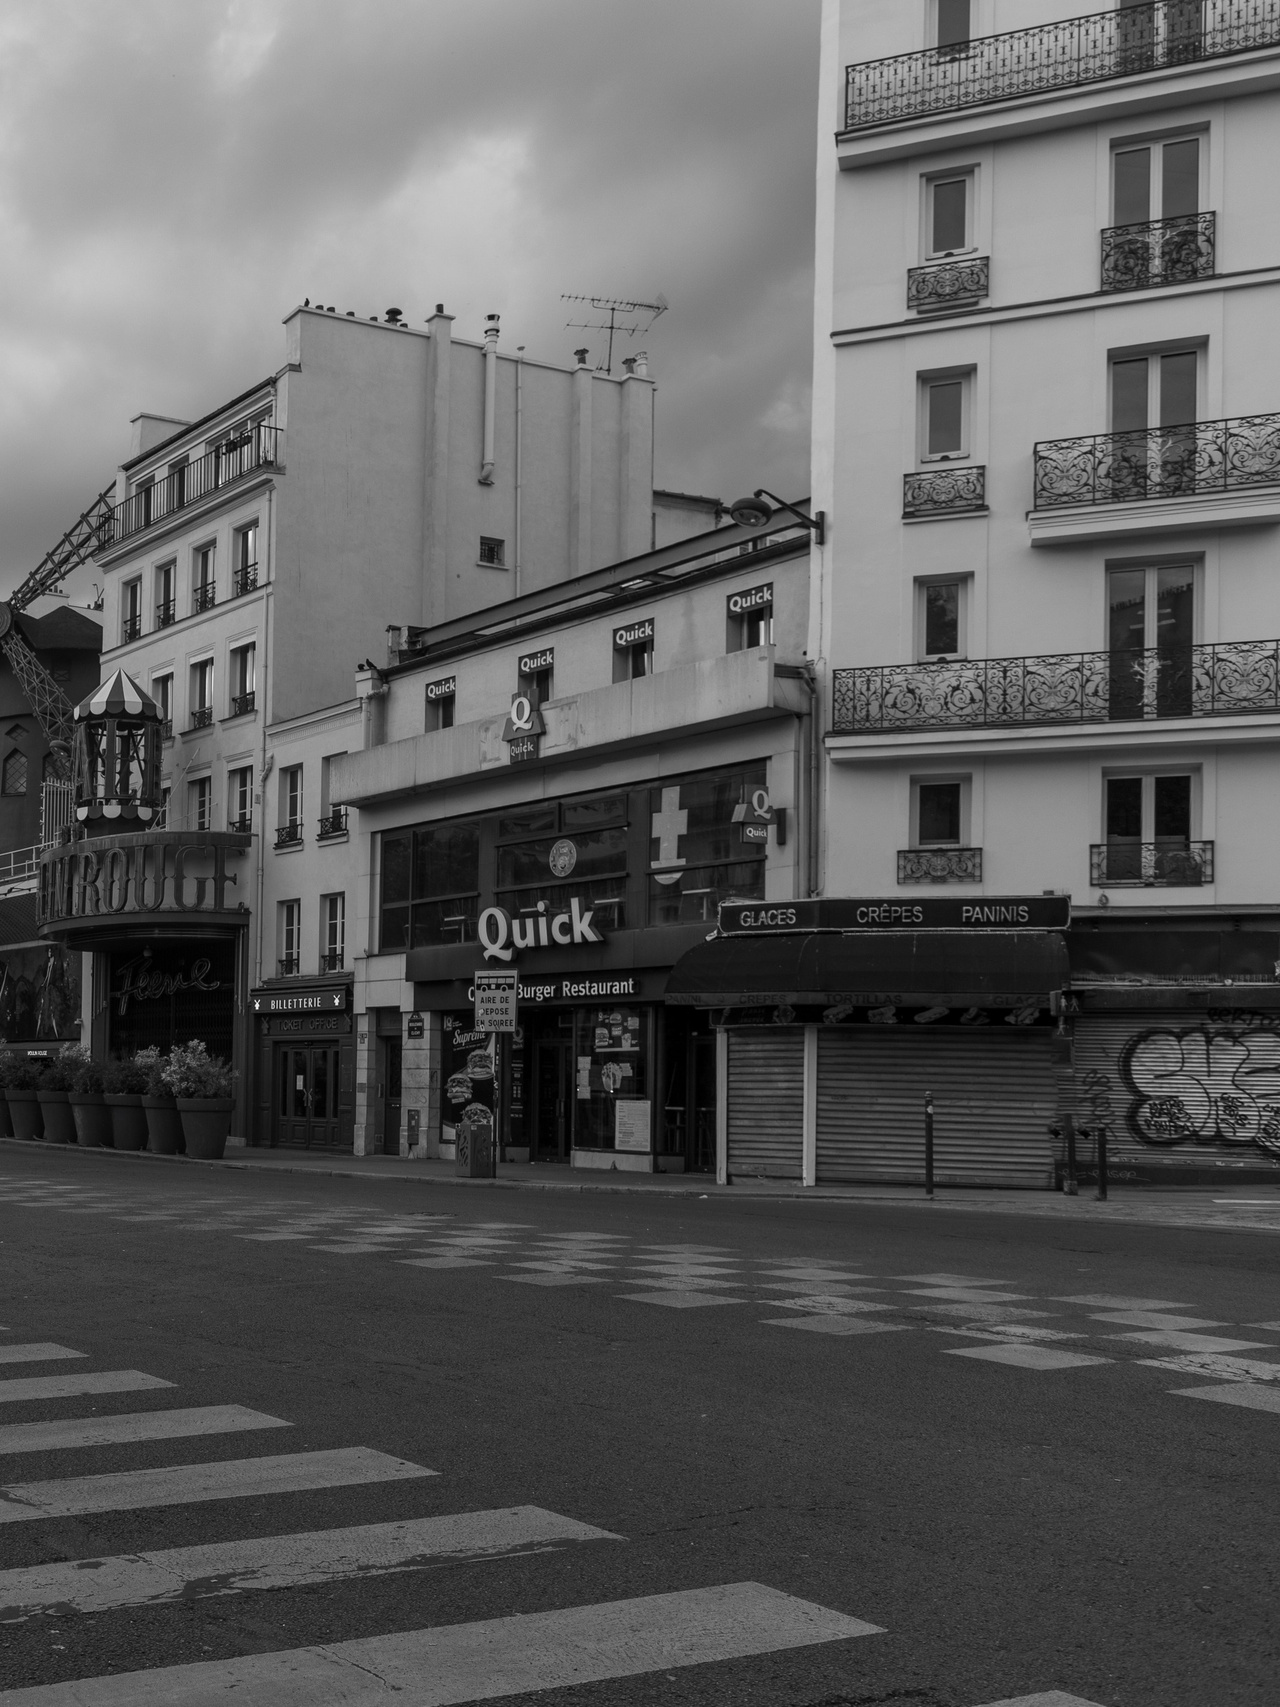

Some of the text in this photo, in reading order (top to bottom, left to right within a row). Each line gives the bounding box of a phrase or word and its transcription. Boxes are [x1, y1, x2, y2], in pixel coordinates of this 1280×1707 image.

[729, 589, 772, 612] Quick
[615, 623, 653, 645] Quick
[520, 651, 553, 672] Quick
[427, 678, 456, 698] Quick
[510, 696, 534, 732] Q
[510, 741, 534, 757] Quick
[752, 789, 771, 820] Q
[746, 827, 767, 838] Quick
[77, 844, 245, 915] ROUGE
[739, 903, 1029, 927] GLACES CRÊPES PANINIS
[478, 896, 605, 962] Quick
[517, 977, 634, 1001] Burger Restaurant
[739, 994, 787, 1005] CREPES
[824, 993, 903, 1005] TORTILLAS
[270, 996, 321, 1010] BILLETTERIE
[500, 996, 509, 1004] DE
[276, 1018, 338, 1031] TICKET OFFICE
